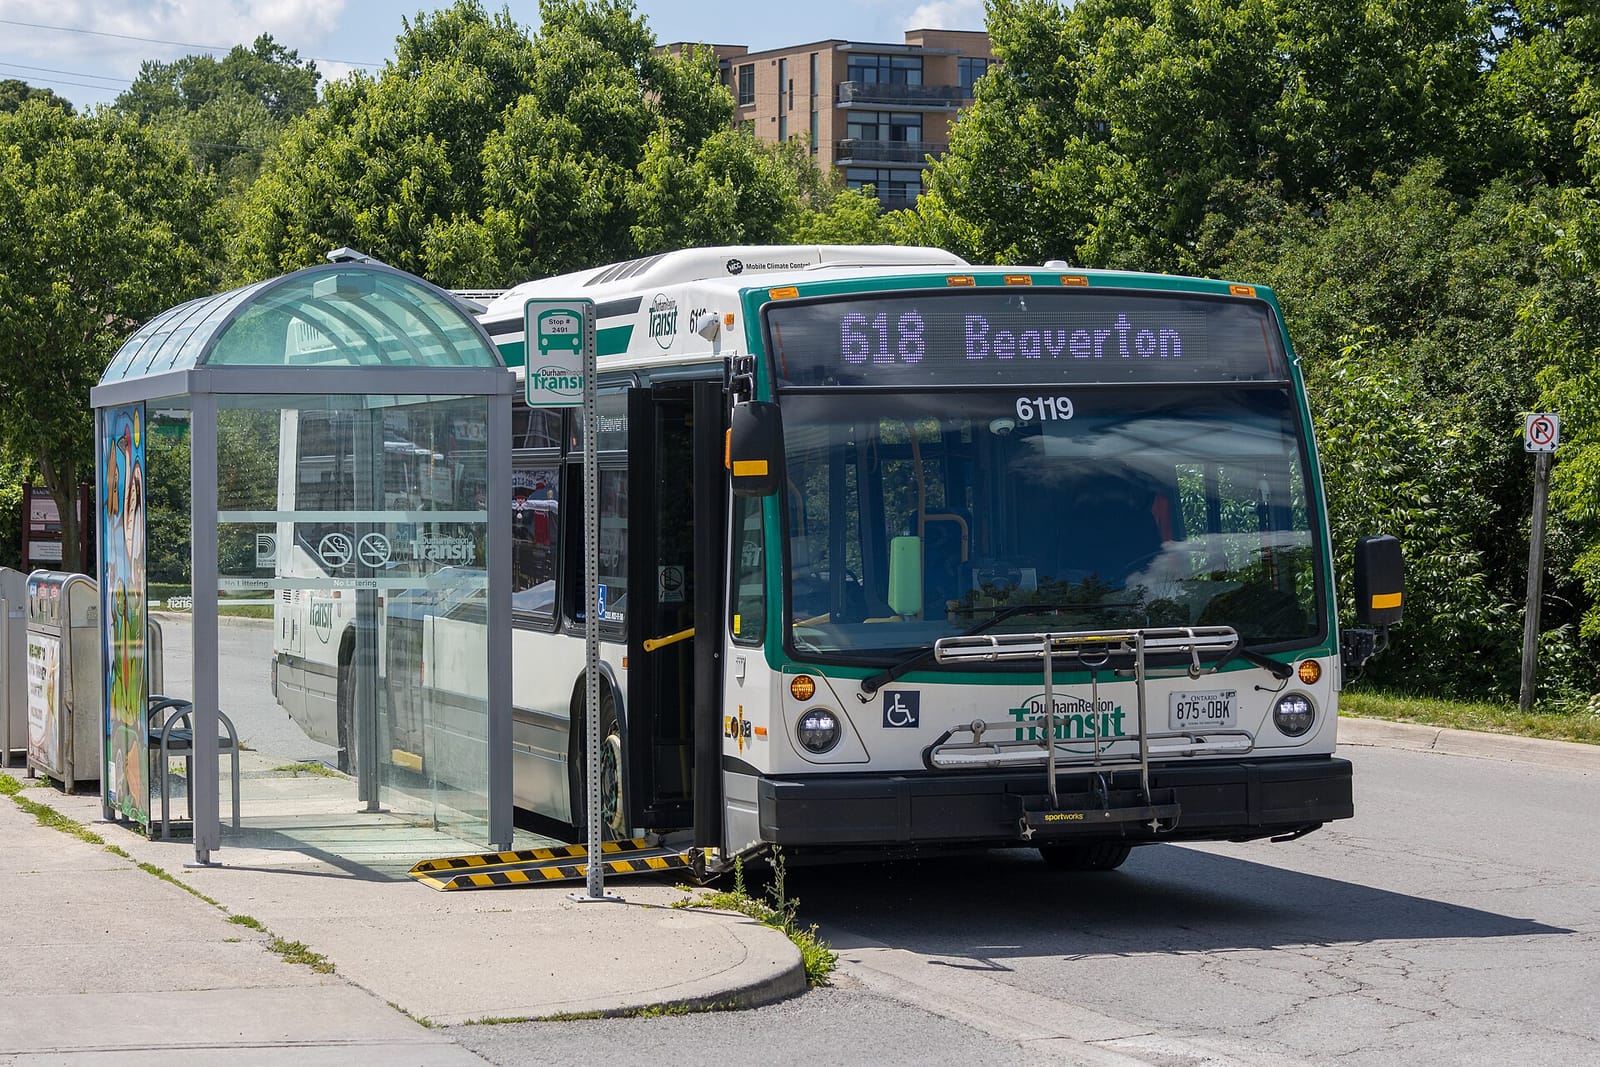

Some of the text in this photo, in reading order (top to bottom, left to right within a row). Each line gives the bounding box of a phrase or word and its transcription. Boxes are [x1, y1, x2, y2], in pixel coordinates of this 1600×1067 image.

[767, 262, 789, 270] Climate
[548, 318, 564, 326] Stop
[649, 304, 678, 338] Transit
[689, 307, 707, 334] 61
[841, 311, 1183, 365] 618 Beaverton
[531, 373, 584, 390] Transi
[1015, 396, 1074, 421] 6119
[409, 539, 477, 560] Transit
[237, 579, 269, 588] Littering
[1030, 697, 1114, 714] DuhamReion
[1190, 694, 1218, 702] ONTARIO
[1176, 701, 1200, 720] 875
[1044, 812, 1084, 821] sportworks
